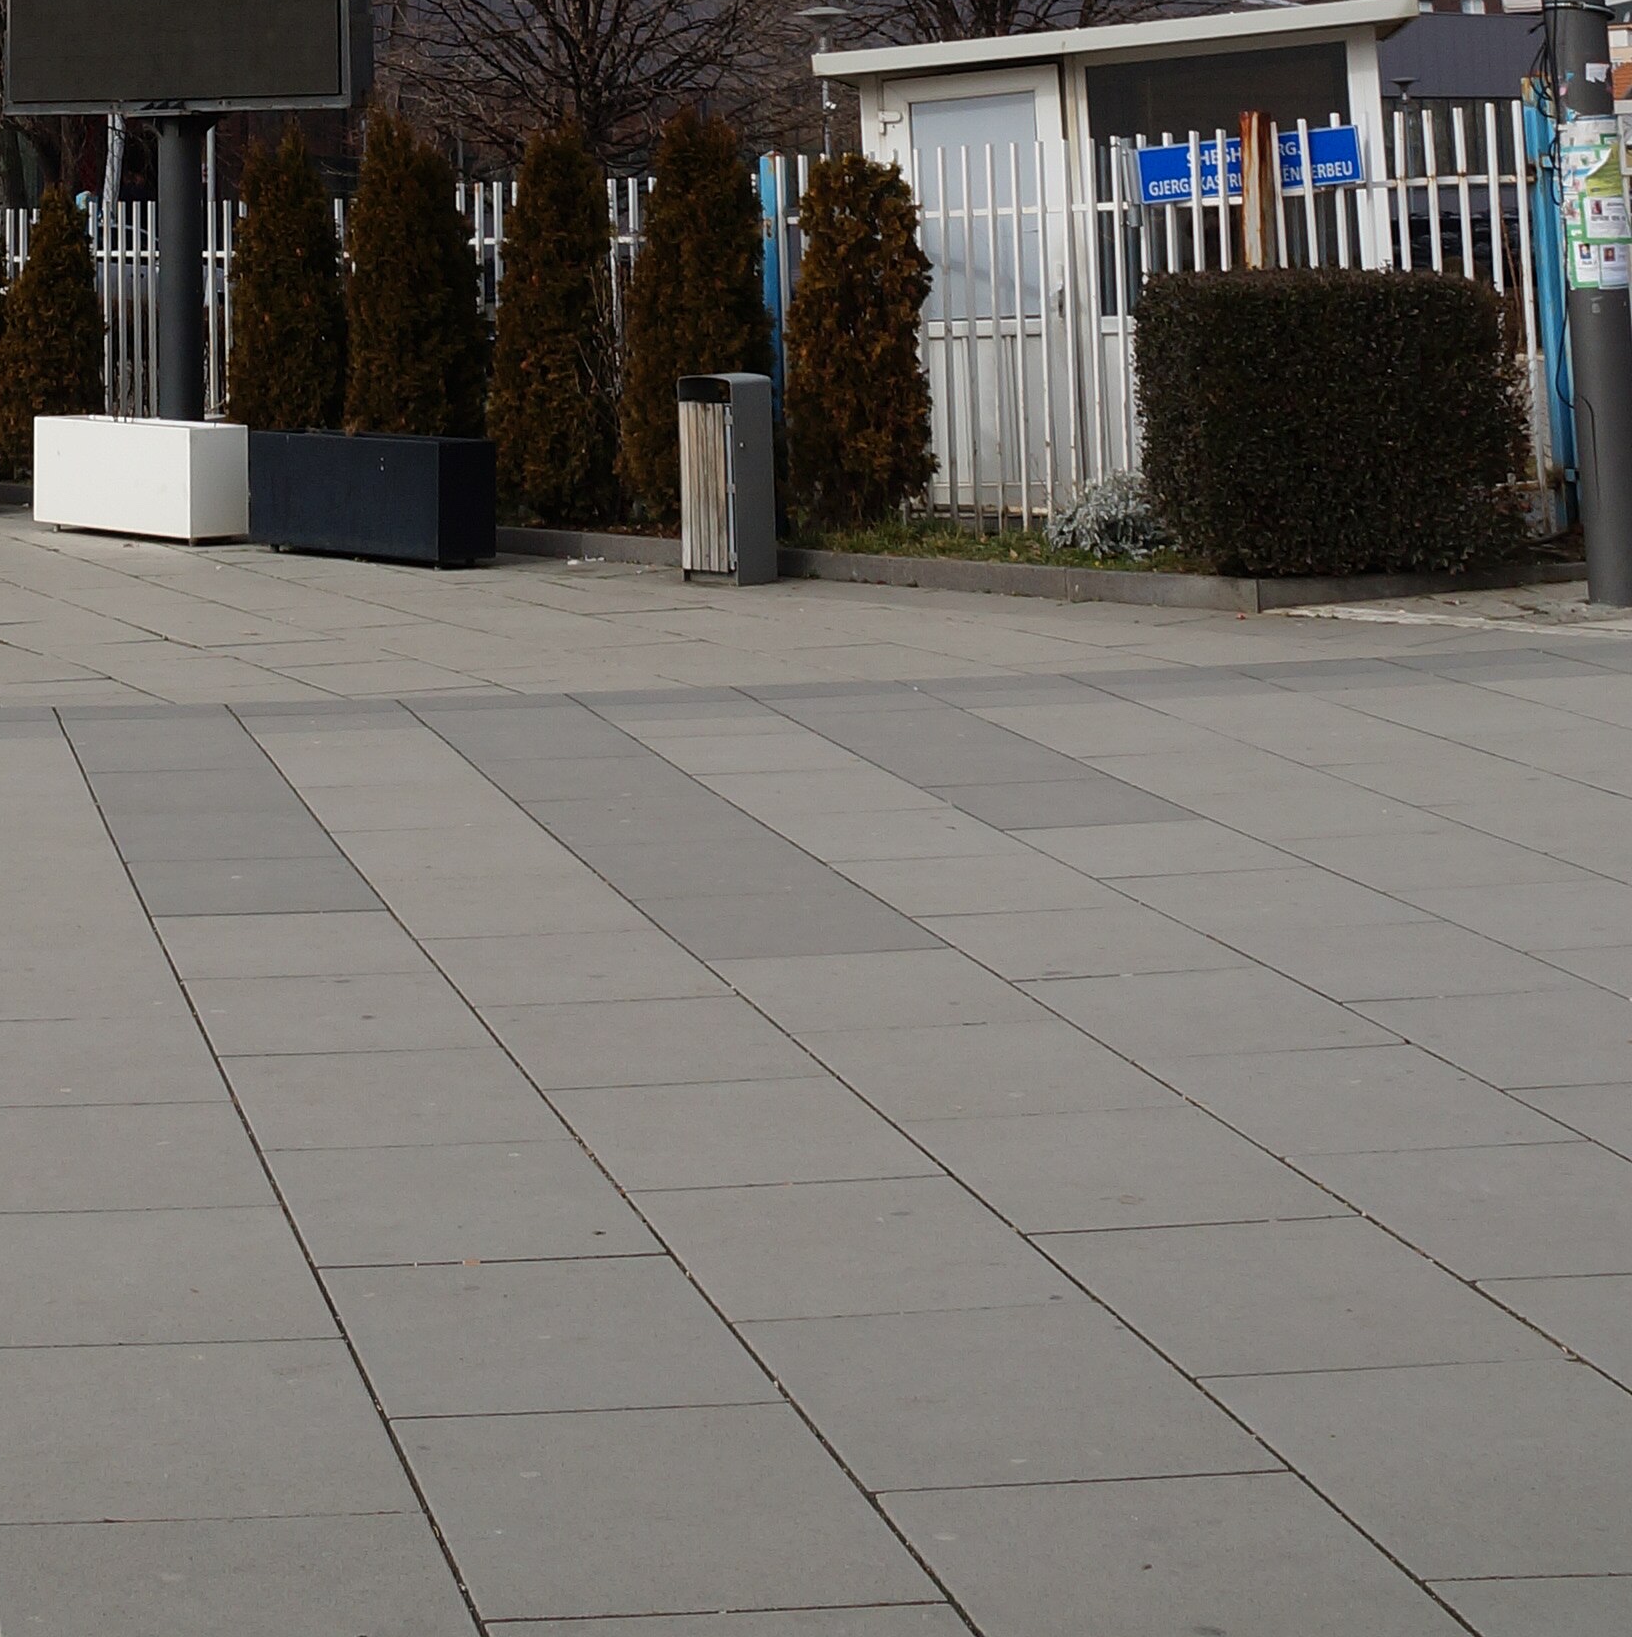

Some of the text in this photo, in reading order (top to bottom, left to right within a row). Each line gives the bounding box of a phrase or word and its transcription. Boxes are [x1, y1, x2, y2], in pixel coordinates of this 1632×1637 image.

[1186, 147, 1242, 167] HEH
[1148, 177, 1192, 196] GJERG
[1282, 160, 1353, 182] ËNERBEU
